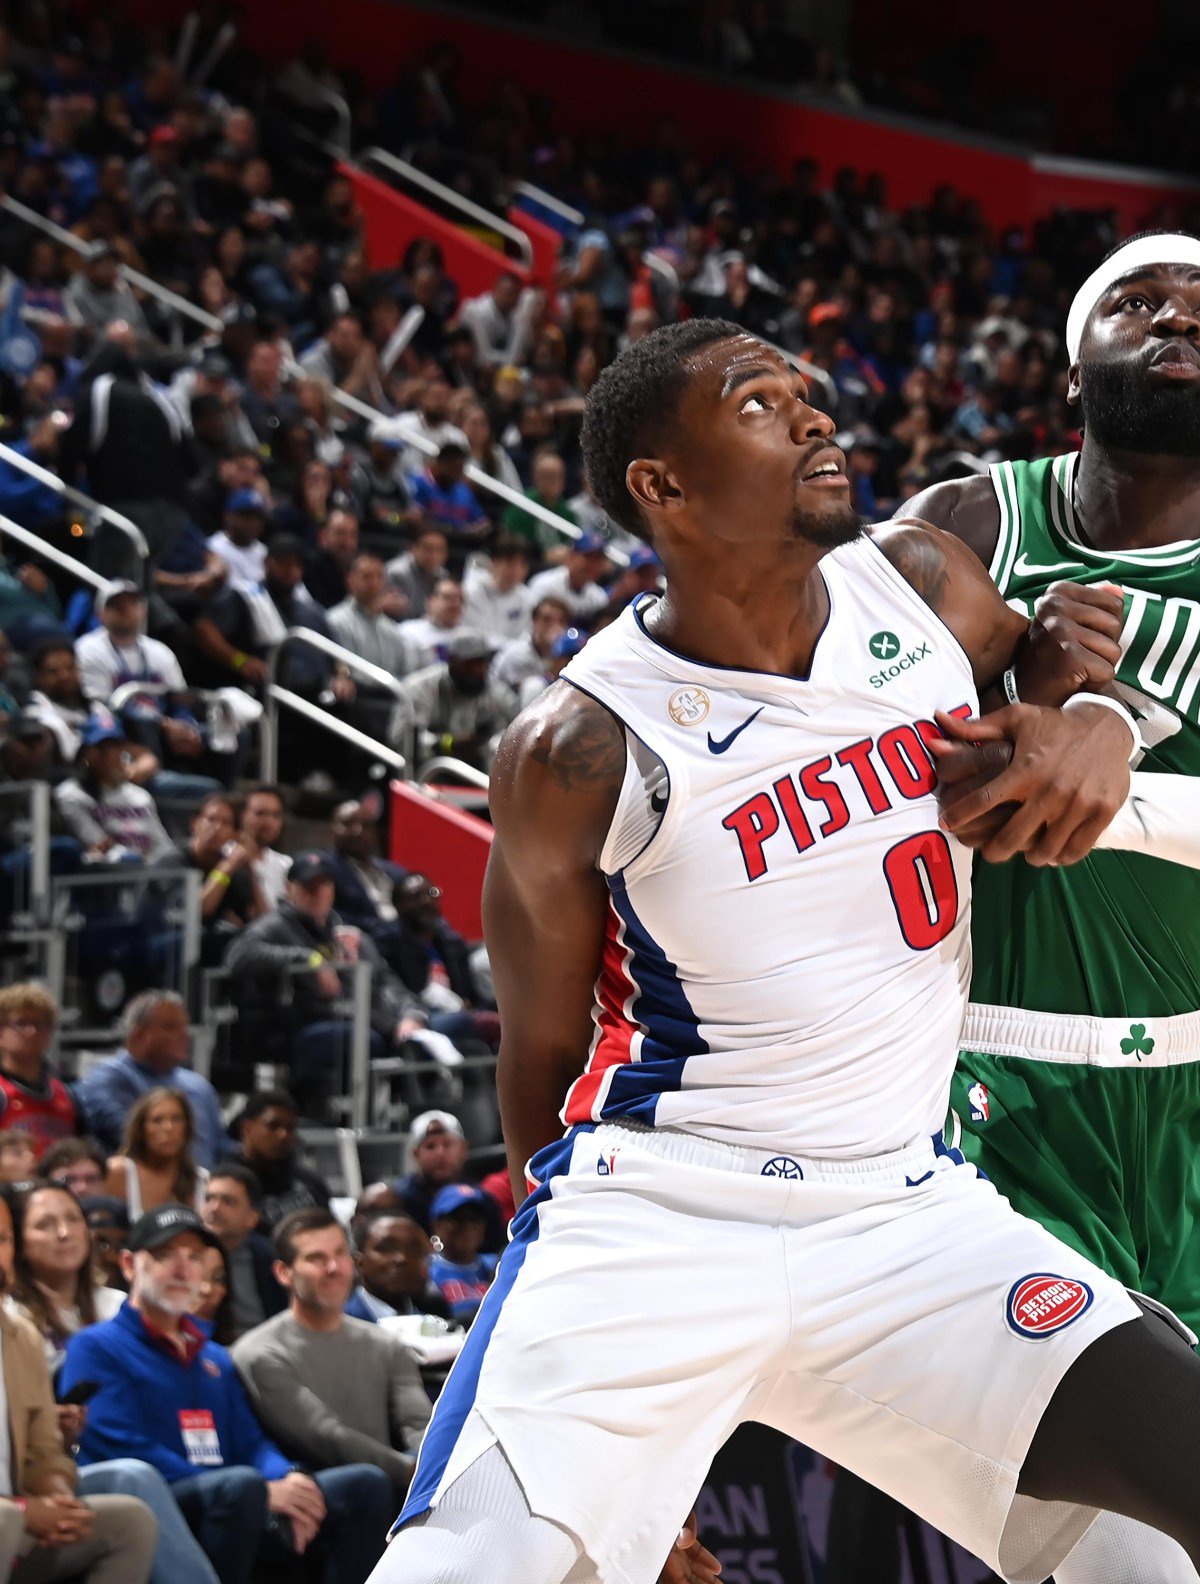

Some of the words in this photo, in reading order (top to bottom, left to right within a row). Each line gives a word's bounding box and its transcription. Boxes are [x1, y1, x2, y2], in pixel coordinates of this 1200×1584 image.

[869, 641, 932, 688] StockX
[721, 703, 973, 883] PISTO
[882, 829, 958, 952] 0
[1020, 1281, 1068, 1315] DETROIT
[1028, 1287, 1078, 1322] PISTONS
